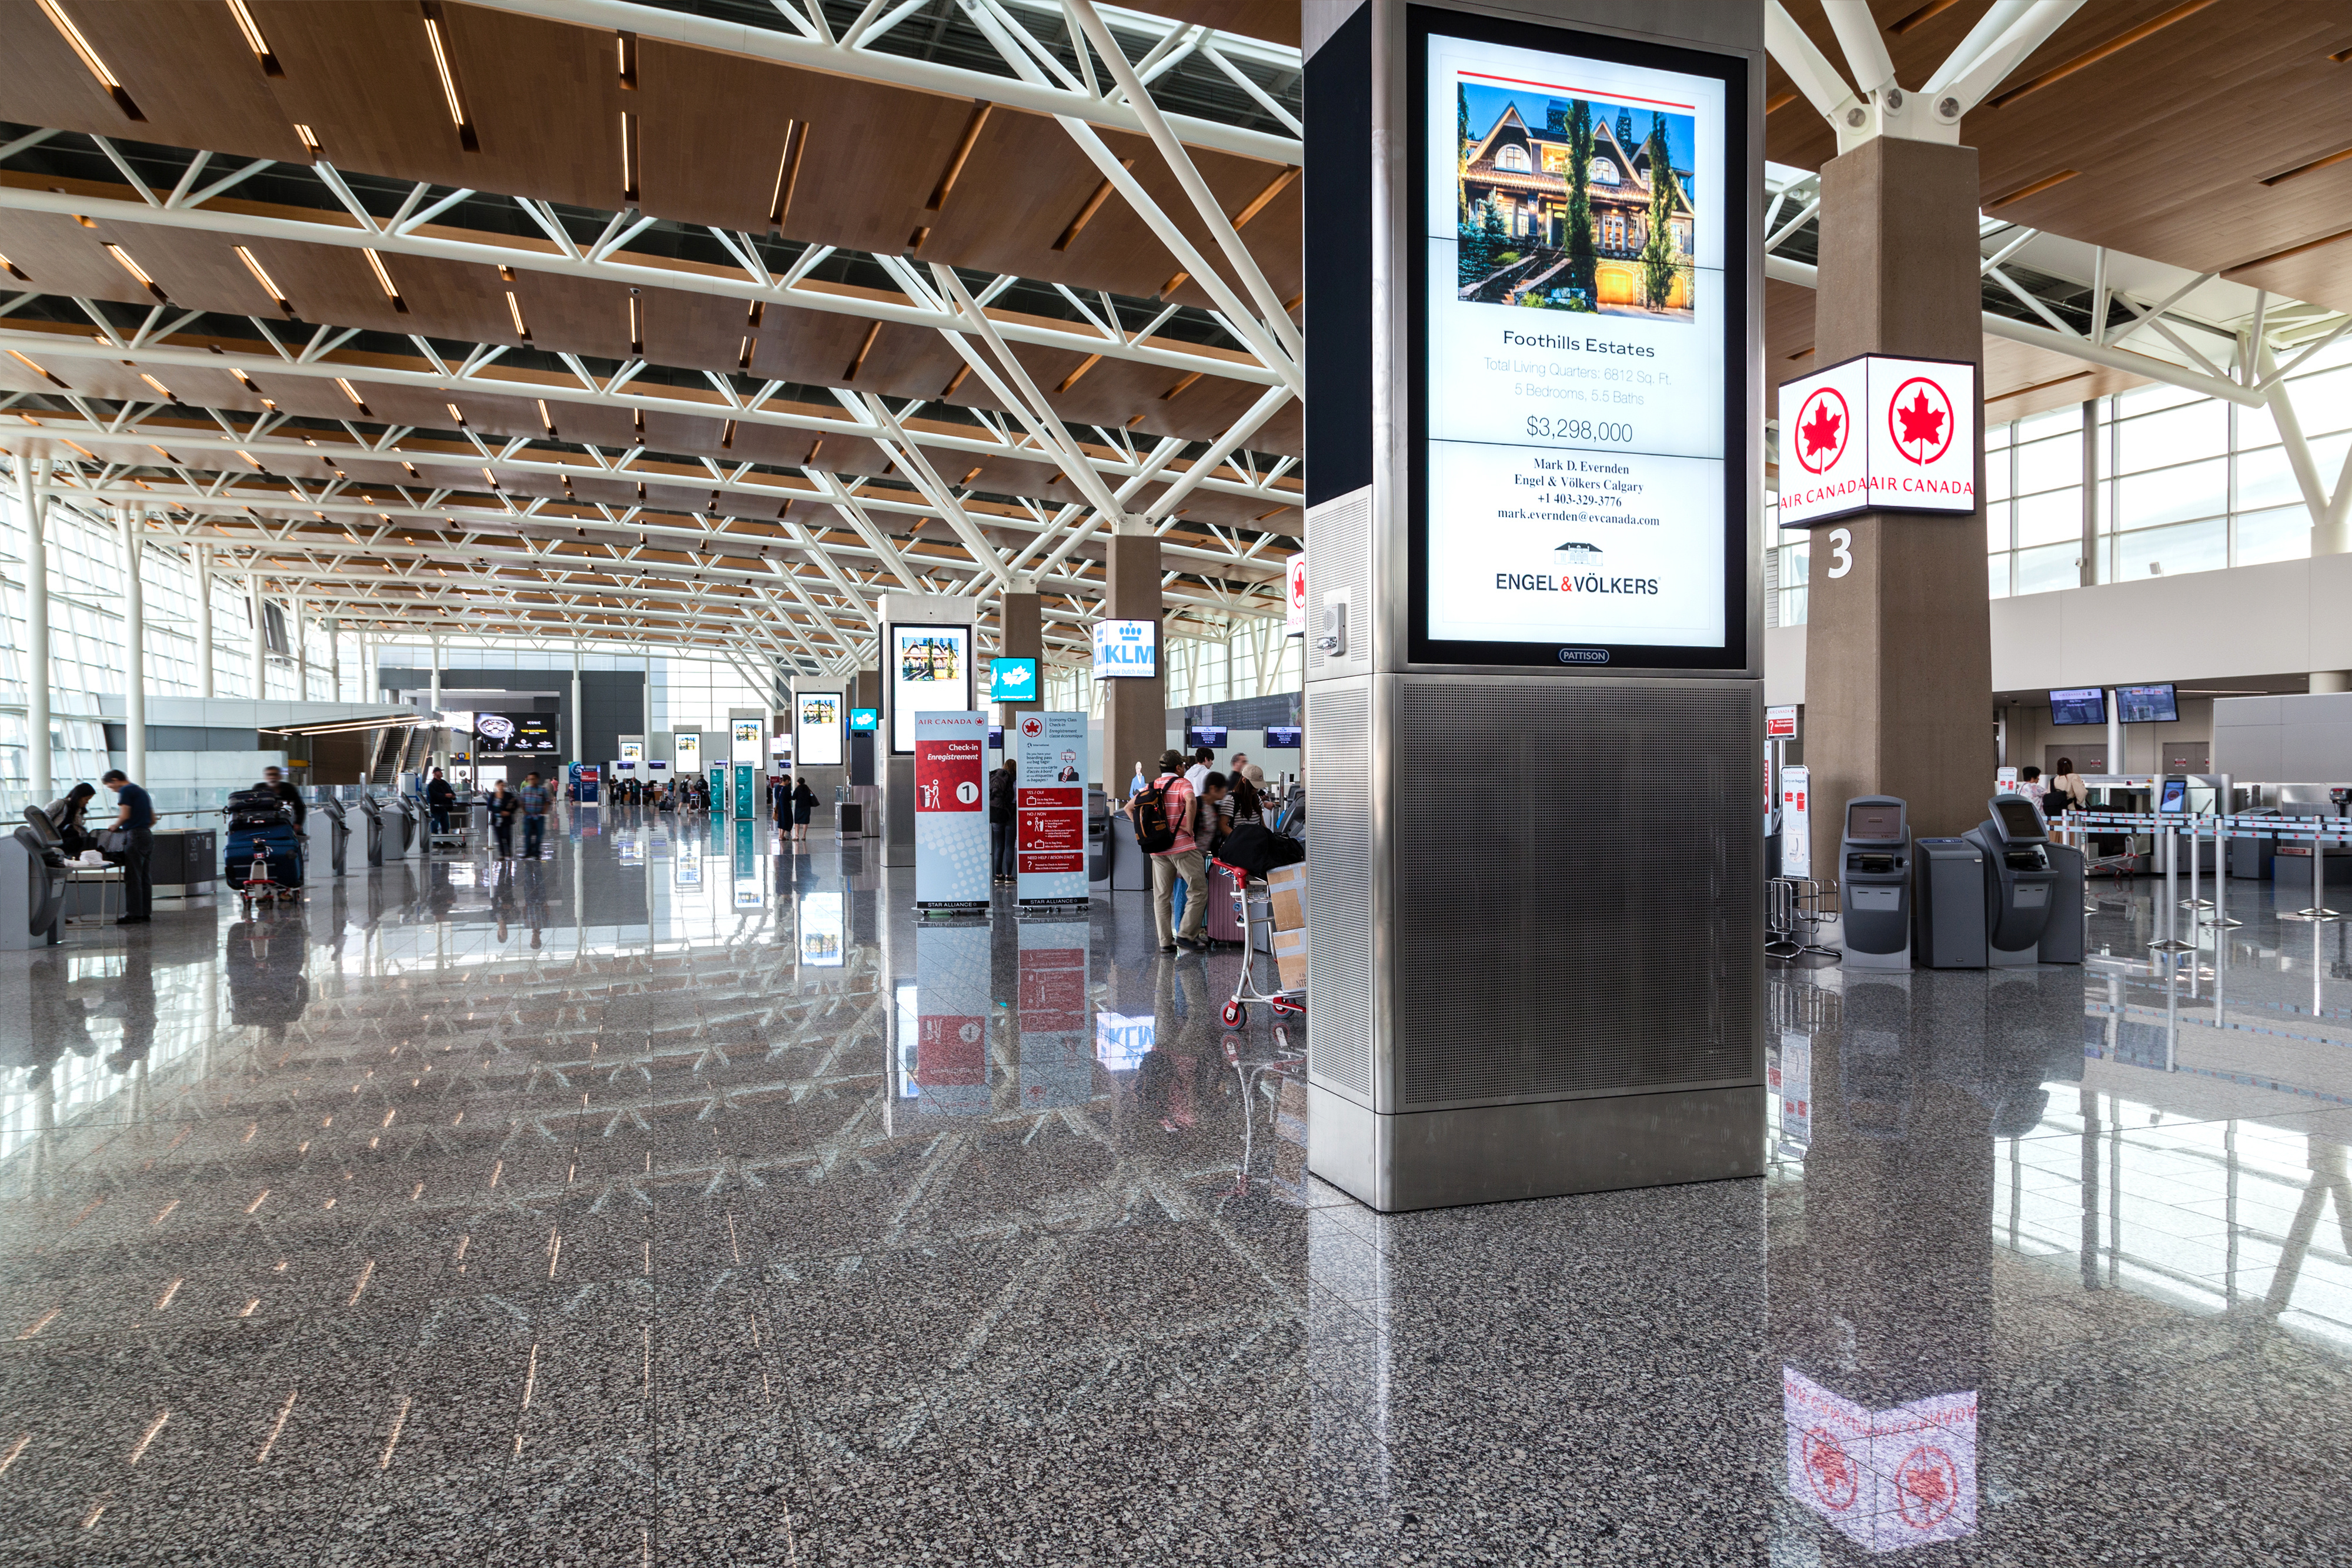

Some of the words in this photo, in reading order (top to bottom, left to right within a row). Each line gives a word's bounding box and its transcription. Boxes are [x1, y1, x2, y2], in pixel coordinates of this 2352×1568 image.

[1503, 330, 1580, 350] Foothills
[1586, 338, 1655, 357] Estates
[1484, 357, 1510, 370] Total
[1514, 360, 1545, 377] Living
[1549, 363, 1600, 379] Quarters:
[1604, 368, 1633, 382] 6812
[1636, 370, 1655, 386] Sq.
[1659, 373, 1671, 385] Ft.
[1515, 383, 1522, 395] 5
[1526, 383, 1587, 402] Bedrooms,
[1591, 390, 1609, 402] 5.5
[1613, 390, 1643, 404] Baths
[1526, 414, 1632, 443] $3,298,000
[1534, 458, 1563, 470] Mark
[1566, 460, 1576, 471] D.
[1580, 462, 1629, 474] Evernden
[1514, 474, 1544, 488] Engel
[1548, 476, 1556, 486] &
[1561, 477, 1600, 489] Völkers
[1603, 480, 1643, 494] Calgary
[1779, 494, 1802, 510] AIR
[1806, 477, 1867, 503] CANADA
[1867, 476, 1896, 490] AIR
[1903, 478, 1973, 495] CANADA
[1538, 493, 1549, 503] +1
[1554, 493, 1622, 507] 403-329-3776
[1498, 509, 1659, 526] mark.evernden@evcanada.com
[1828, 527, 1853, 579] 3
[1295, 616, 1305, 624] CAN
[1093, 646, 1107, 666] KLM
[1107, 645, 1154, 664] KLM
[1563, 652, 1605, 660] PATTISON
[1106, 682, 1111, 701] 5
[962, 785, 969, 801] 1
